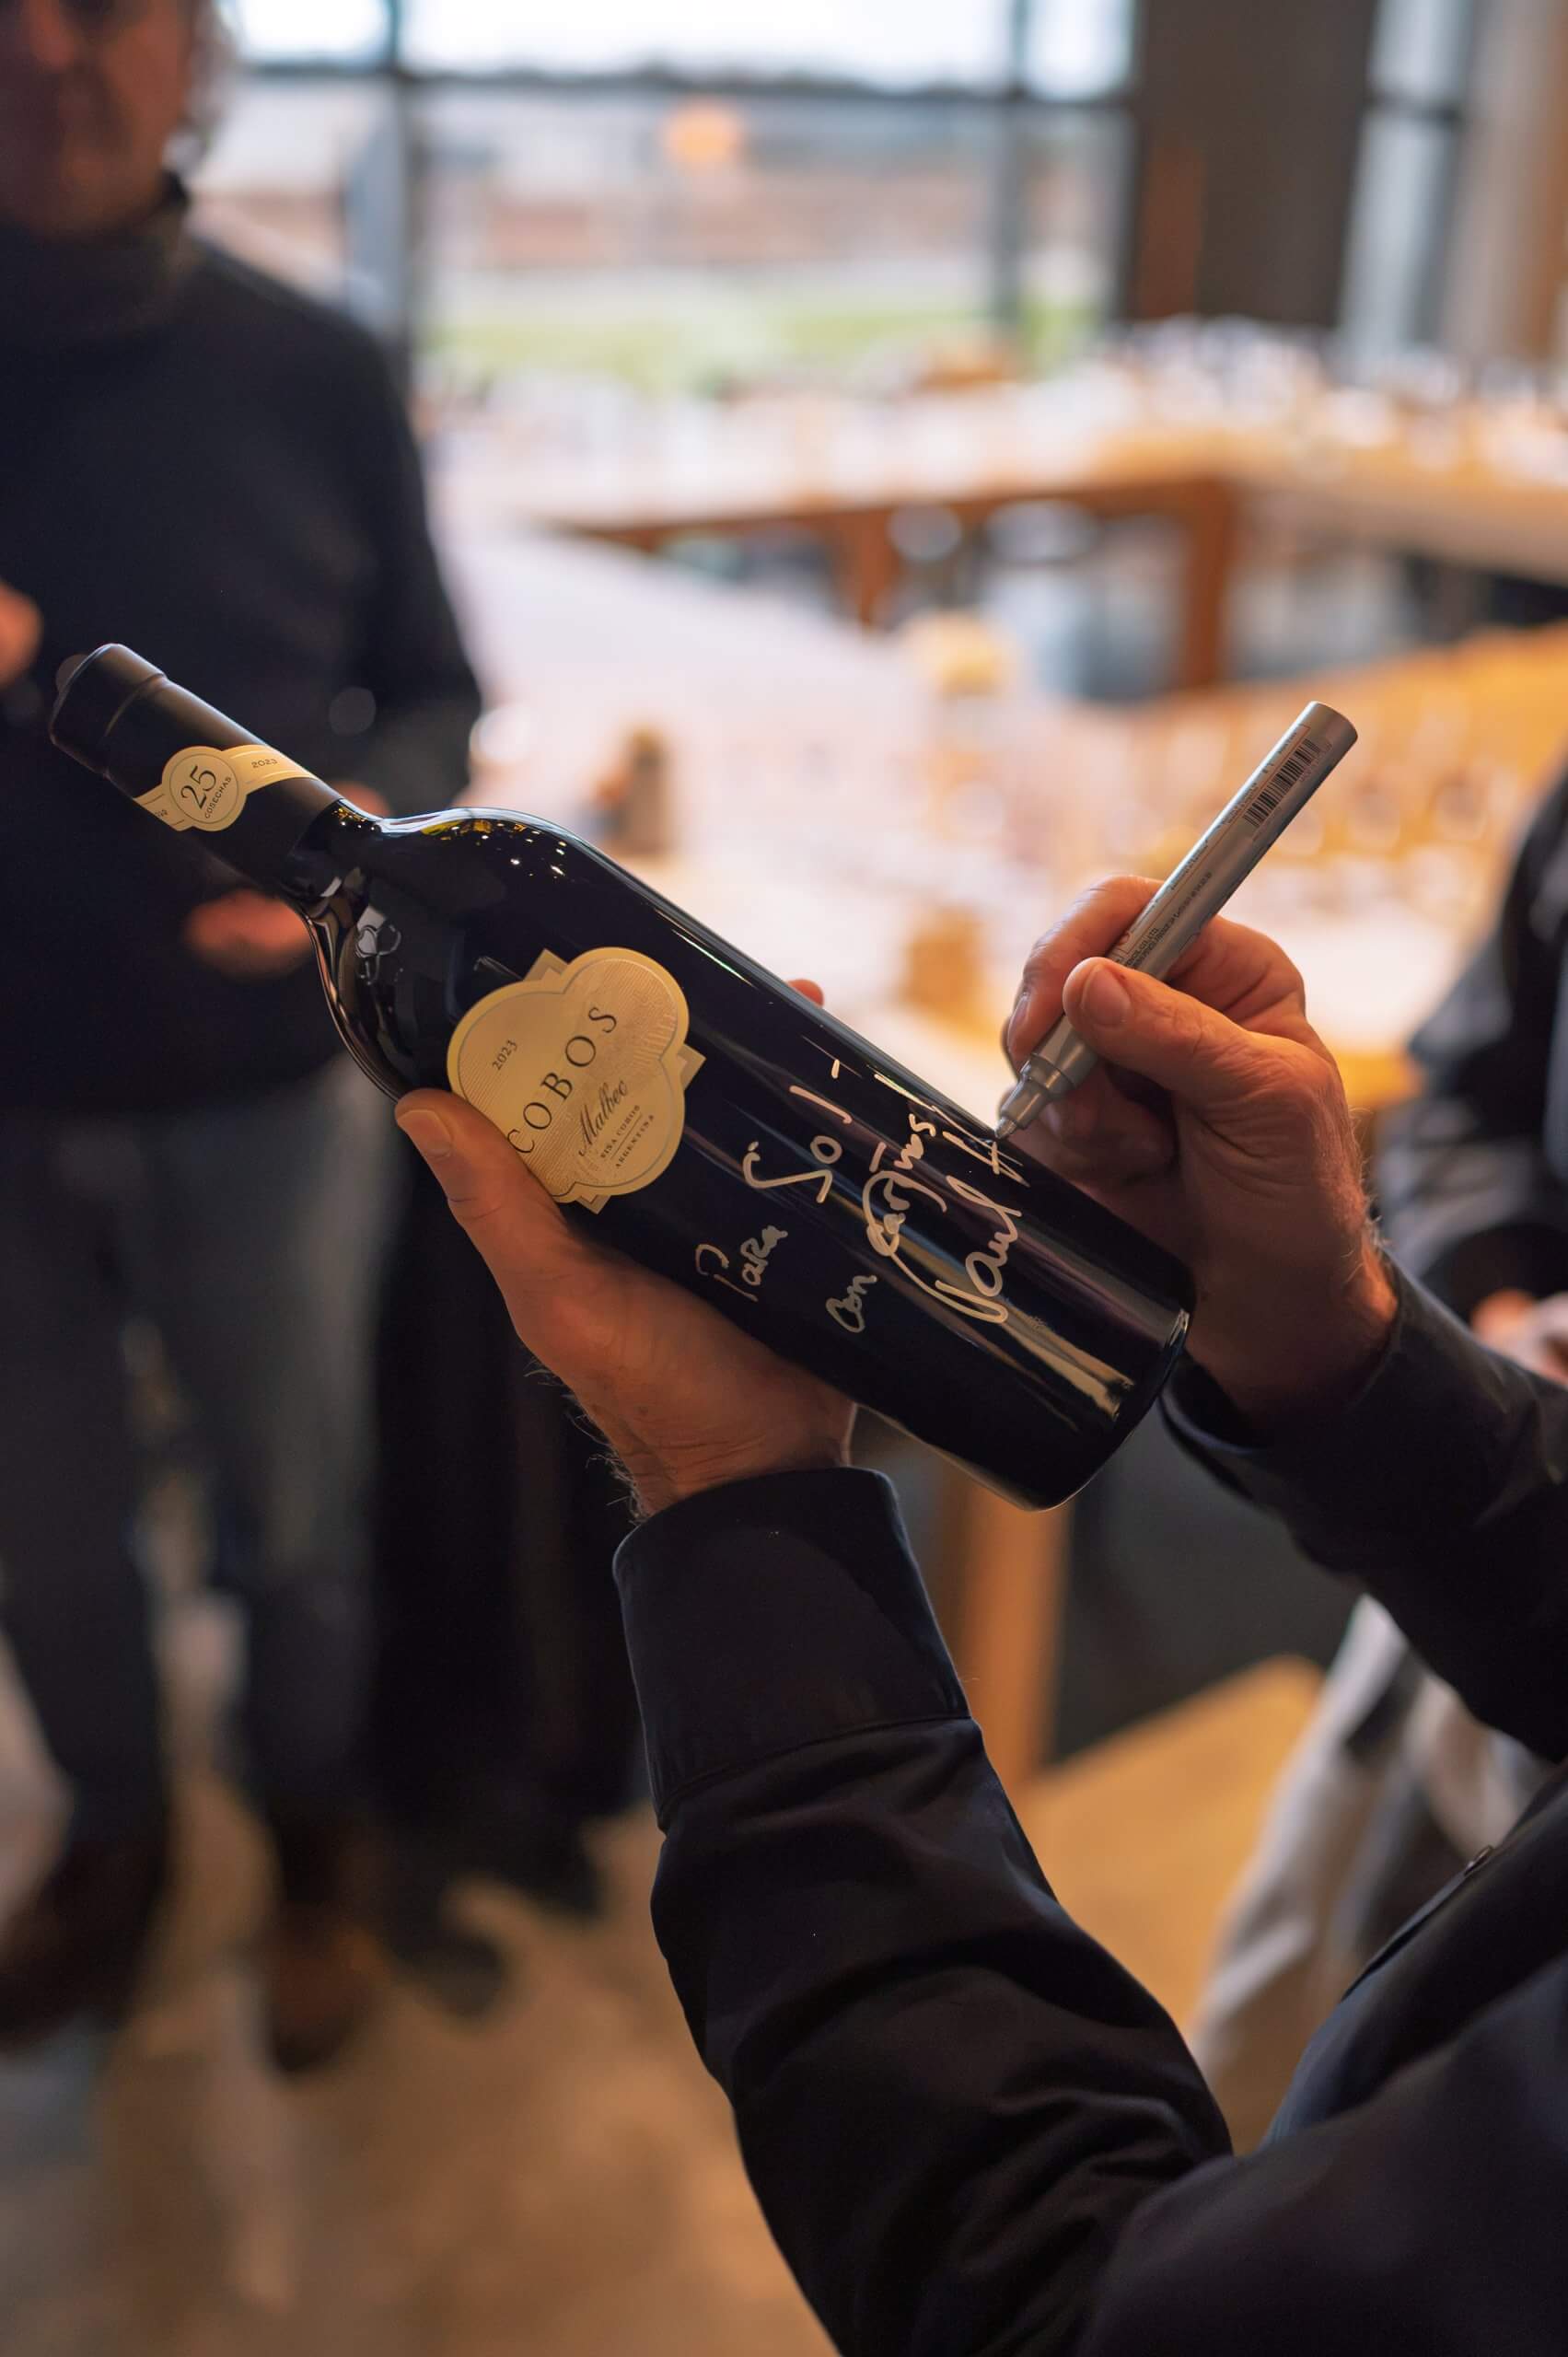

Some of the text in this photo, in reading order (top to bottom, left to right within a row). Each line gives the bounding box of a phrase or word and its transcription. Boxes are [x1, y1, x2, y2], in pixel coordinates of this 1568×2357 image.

[250, 758, 278, 769] 2023
[180, 764, 217, 809] 25
[203, 776, 232, 819] COSECHAS
[492, 1039, 517, 1071] 2023
[507, 1007, 617, 1154] COBOS
[578, 1080, 628, 1157] Malbec
[615, 1114, 655, 1168] ARGENTINA
